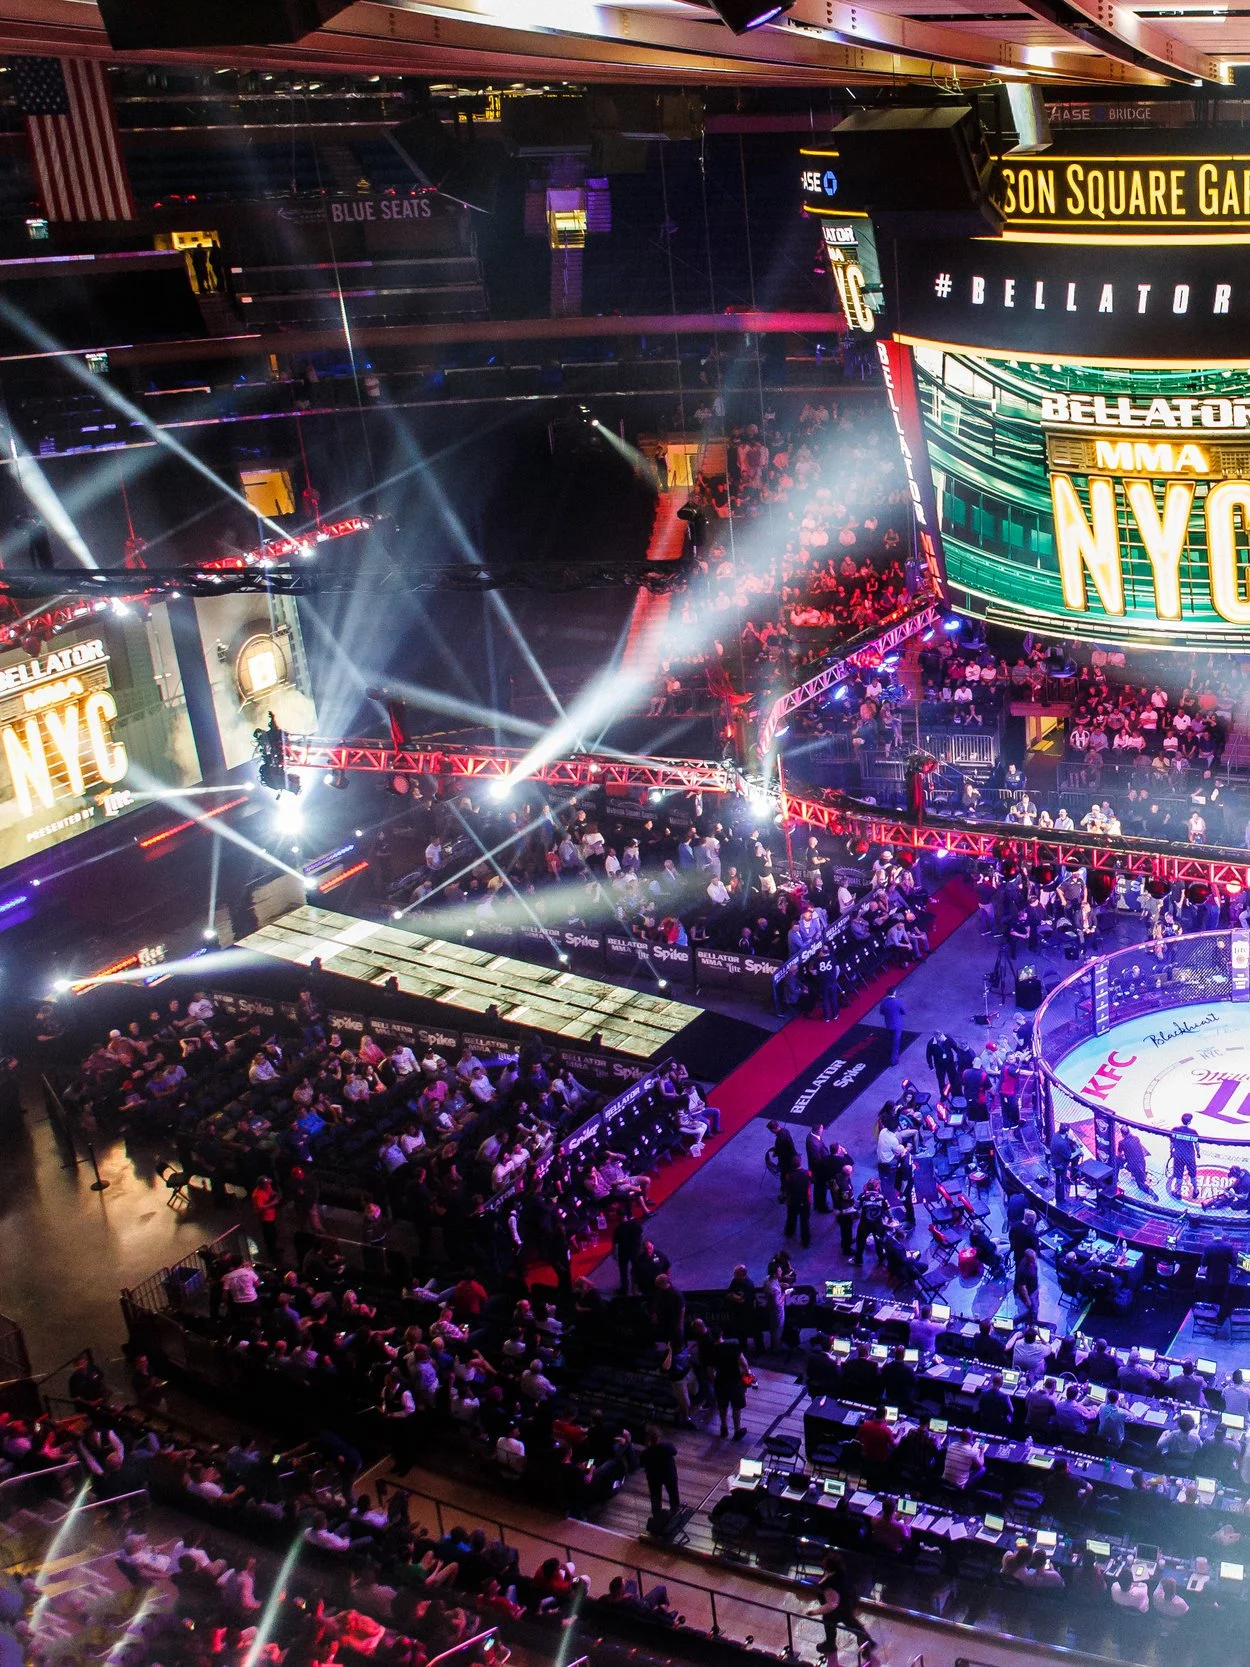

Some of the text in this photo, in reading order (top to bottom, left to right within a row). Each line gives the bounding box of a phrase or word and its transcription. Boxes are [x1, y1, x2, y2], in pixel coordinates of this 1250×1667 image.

[1109, 107, 1151, 121] BRIDGE
[800, 171, 822, 192] ASE
[1067, 163, 1186, 219] SQUARE
[331, 201, 377, 223] BLUE
[381, 199, 432, 219] SEATS
[876, 340, 927, 526] BELLATOR
[1095, 440, 1210, 473] MMA
[23, 676, 85, 713] MMA
[1, 690, 129, 817] NYC
[26, 806, 95, 842] PRESENTED BY
[564, 932, 600, 949] Spike
[607, 937, 649, 951] BELLATOR
[653, 945, 689, 962] Spike
[697, 951, 740, 964] BELLATOR
[701, 957, 723, 968] MMA
[819, 960, 832, 972] 86
[418, 1029, 457, 1048] Spike
[1142, 1012, 1220, 1048] Blackheart
[464, 1036, 509, 1050] BELLATOR
[789, 1059, 847, 1114] BELLATOR
[833, 1062, 867, 1088] Spike
[1080, 1050, 1138, 1101] KFC
[605, 1086, 640, 1118] BELLATOR
